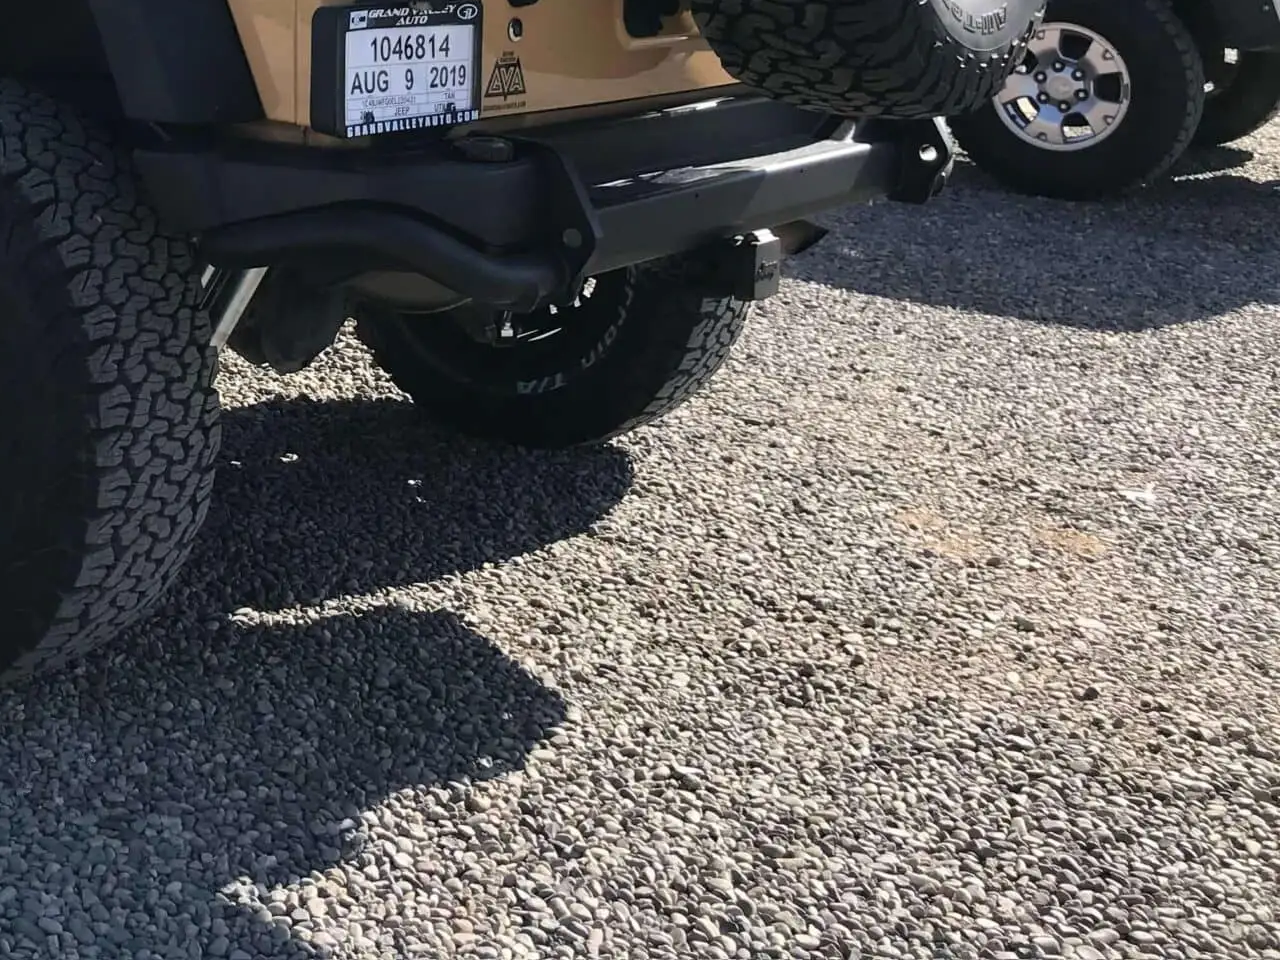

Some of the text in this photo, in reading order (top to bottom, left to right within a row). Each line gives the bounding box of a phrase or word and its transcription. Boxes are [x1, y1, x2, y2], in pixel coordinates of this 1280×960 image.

[368, 7, 410, 18] GRAND
[396, 15, 429, 26] AUTO
[370, 33, 450, 62] 1046814
[350, 64, 466, 96] AUG 9 2019
[394, 106, 410, 117] JEEP
[346, 109, 479, 138] GRANDVALLEYAUTO.COM
